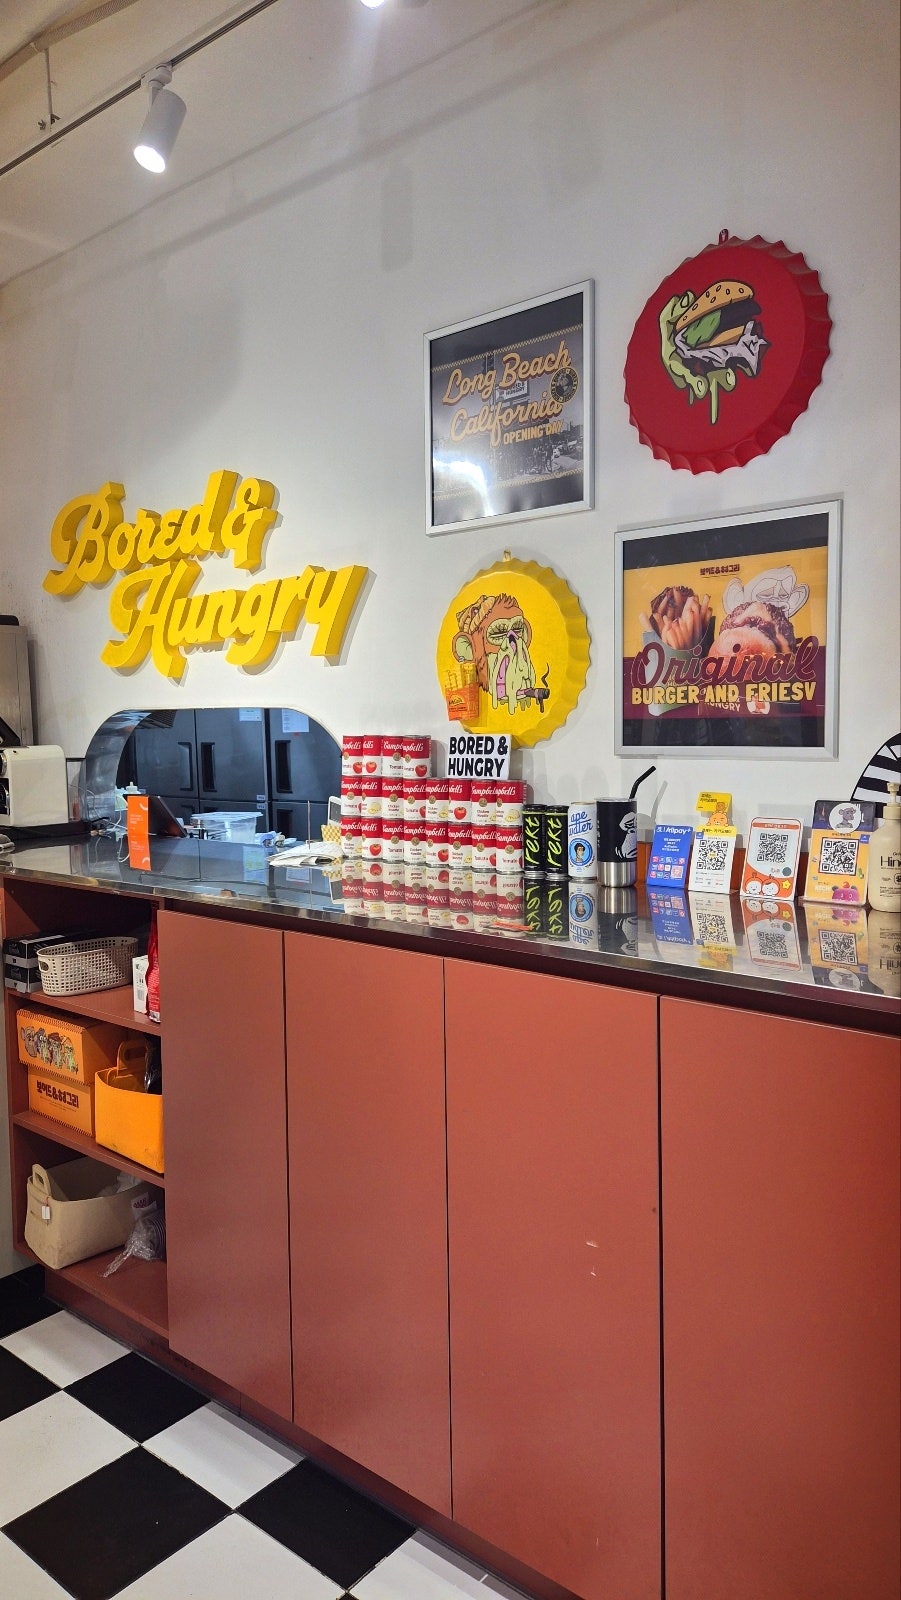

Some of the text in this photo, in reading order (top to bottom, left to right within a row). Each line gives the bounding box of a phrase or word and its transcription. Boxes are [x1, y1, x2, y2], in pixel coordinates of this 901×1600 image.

[443, 368, 497, 405] Long
[499, 341, 573, 389] Beach
[451, 391, 563, 448] California
[503, 420, 563, 445] OPENING DAY
[42, 469, 278, 596] Bored &
[100, 559, 369, 678] Hungry
[631, 636, 819, 688] Original
[632, 685, 699, 704] BURGER
[704, 684, 740, 703] AND
[706, 700, 741, 712] UNGRY
[449, 736, 509, 755] BORED &
[448, 758, 505, 777] HUNGRY
[569, 820, 593, 836] water
[571, 811, 588, 827] ape
[525, 816, 540, 865] rekt
[547, 818, 562, 867] rekt
[880, 855, 901, 867] Hin
